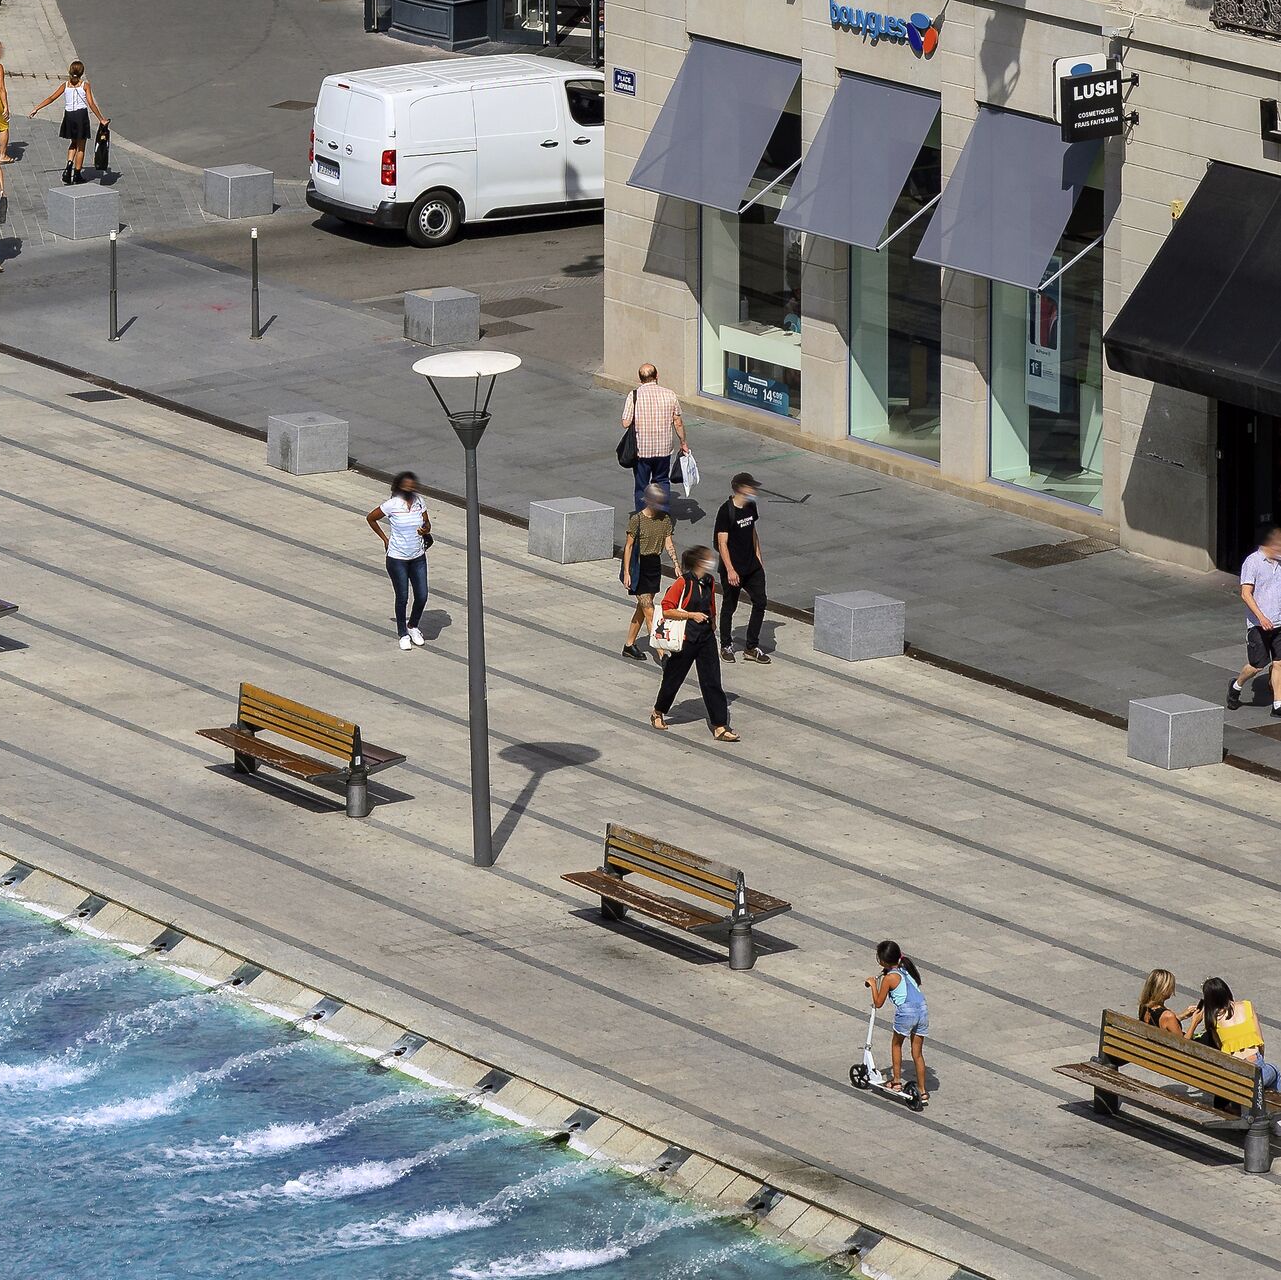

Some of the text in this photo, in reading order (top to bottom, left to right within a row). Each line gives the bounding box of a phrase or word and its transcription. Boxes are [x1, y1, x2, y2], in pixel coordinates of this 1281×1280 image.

[1073, 80, 1118, 101] LUSH
[1077, 107, 1115, 119] COSMETIQUES
[1074, 121, 1090, 129] FRAIS
[1090, 118, 1105, 126] FAITS
[744, 383, 758, 395] fibre
